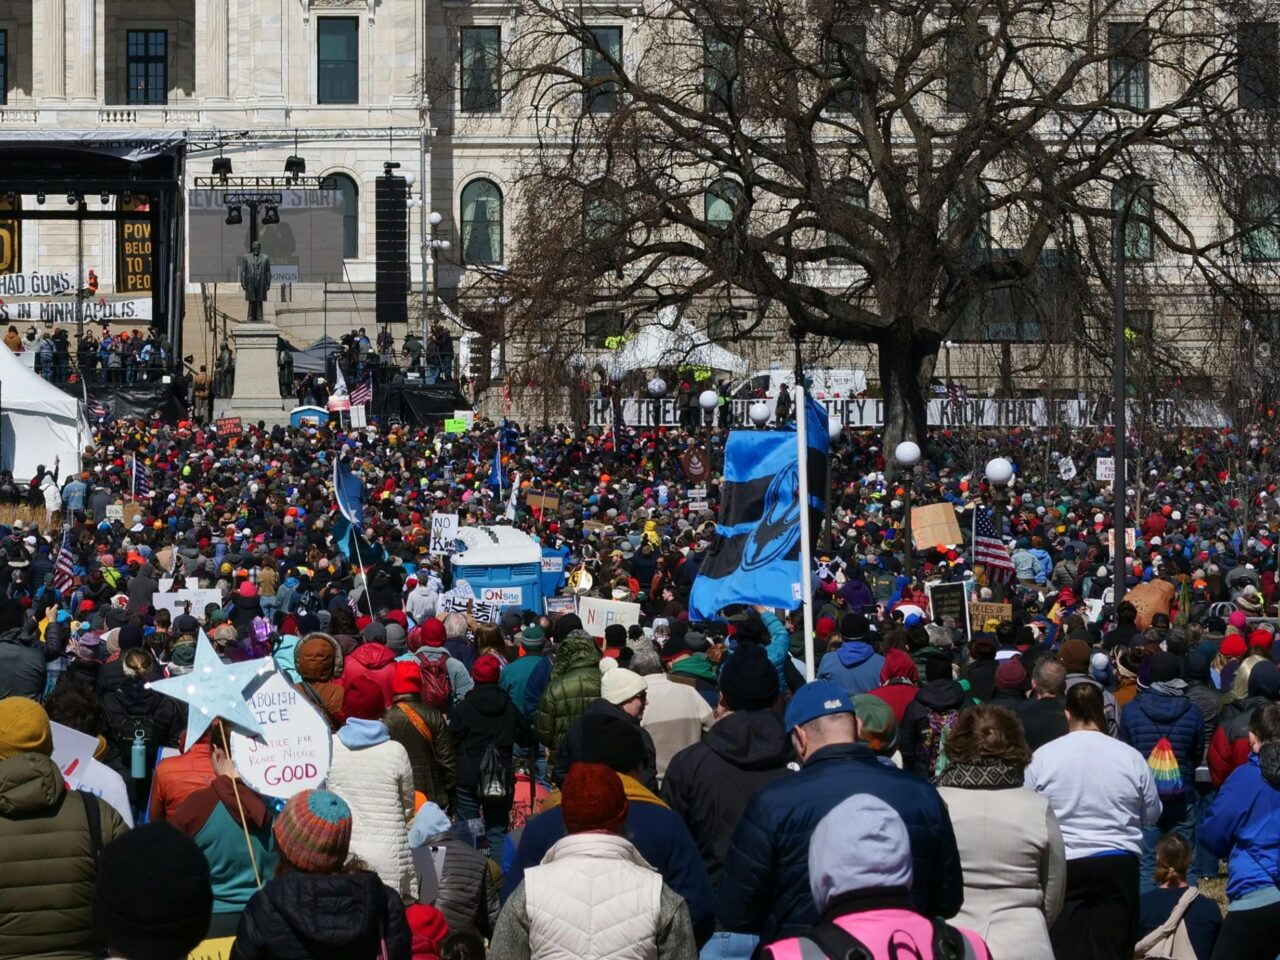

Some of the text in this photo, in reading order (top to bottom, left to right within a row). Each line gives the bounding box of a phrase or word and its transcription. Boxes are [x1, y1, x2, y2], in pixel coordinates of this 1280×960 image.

[125, 241, 151, 255] BELO
[128, 274, 151, 289] PEO
[17, 302, 32, 319] IN
[434, 517, 451, 529] NO
[249, 691, 297, 709] ABOLISH
[255, 708, 289, 725] ICE
[264, 763, 317, 786] GOOD
